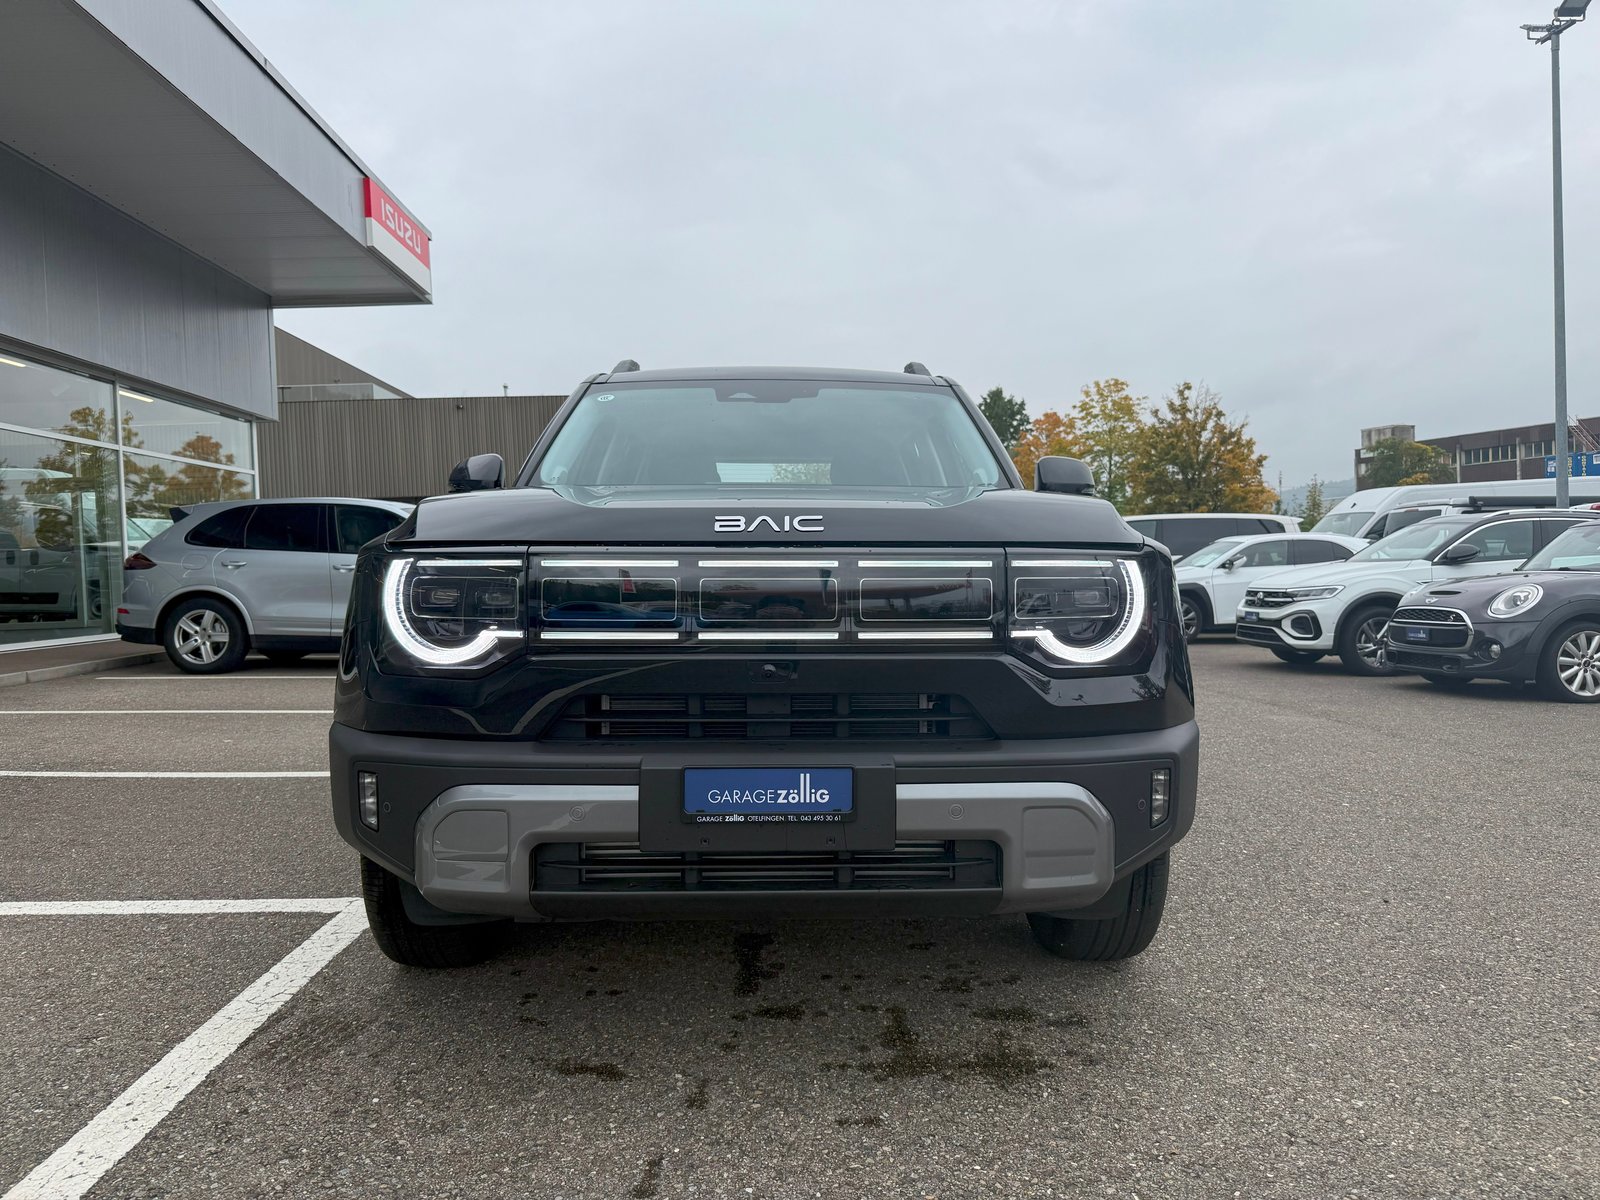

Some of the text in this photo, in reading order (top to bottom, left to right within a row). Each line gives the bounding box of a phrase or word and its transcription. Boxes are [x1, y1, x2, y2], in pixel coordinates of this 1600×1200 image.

[381, 198, 421, 255] ISUZU
[714, 515, 825, 532] BAIC
[707, 789, 775, 804] GARAGE
